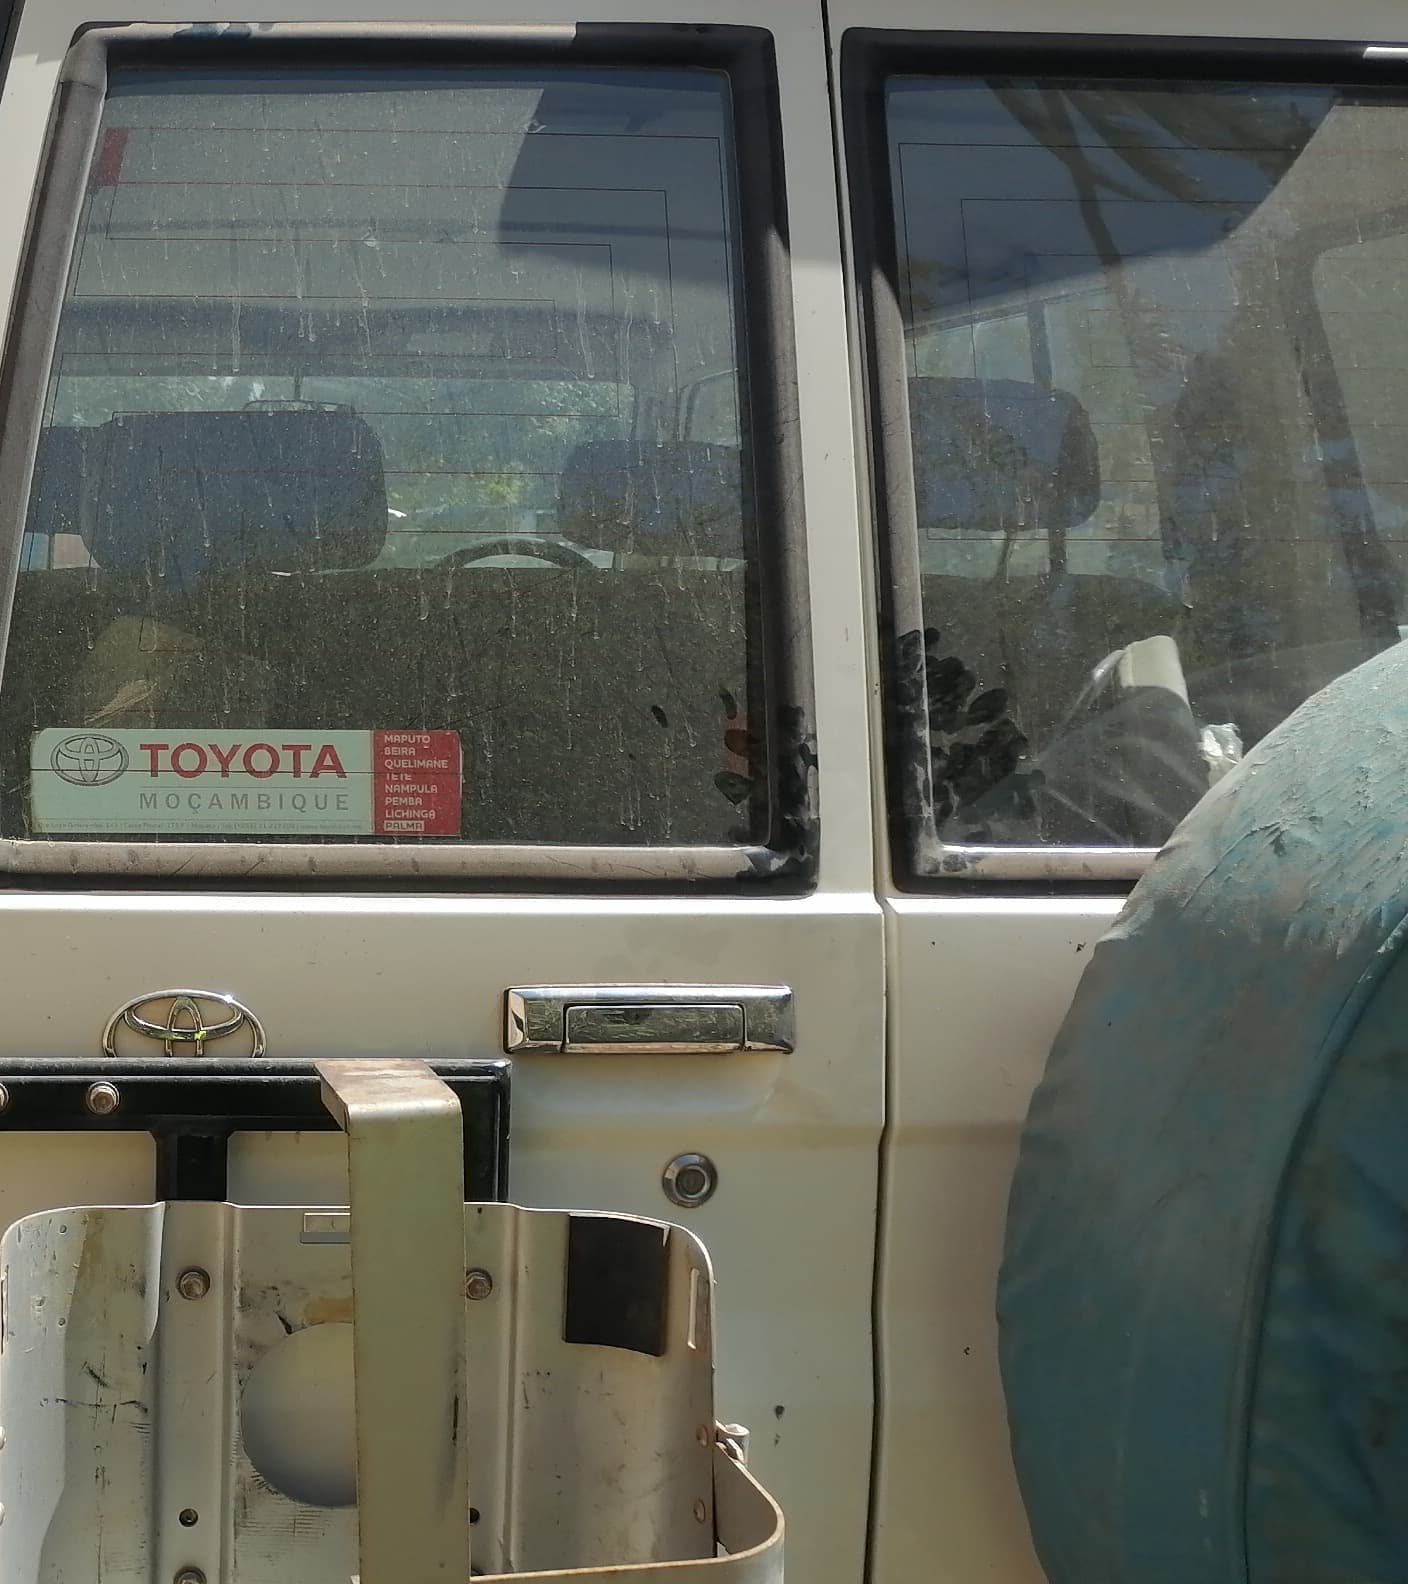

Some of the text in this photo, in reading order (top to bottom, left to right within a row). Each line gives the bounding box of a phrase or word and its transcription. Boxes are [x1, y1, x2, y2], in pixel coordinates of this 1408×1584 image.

[384, 735, 431, 743] MAPUTO
[384, 747, 416, 756] BEIRA
[139, 743, 347, 779] TOYOTA
[384, 760, 449, 769] QUELIMANE
[385, 784, 438, 793] NAMPULA
[139, 792, 349, 814] MOÇAMBIQUE
[385, 797, 423, 806] PEMBA
[385, 809, 436, 819] LICHINGA
[385, 821, 423, 831] PALMA
